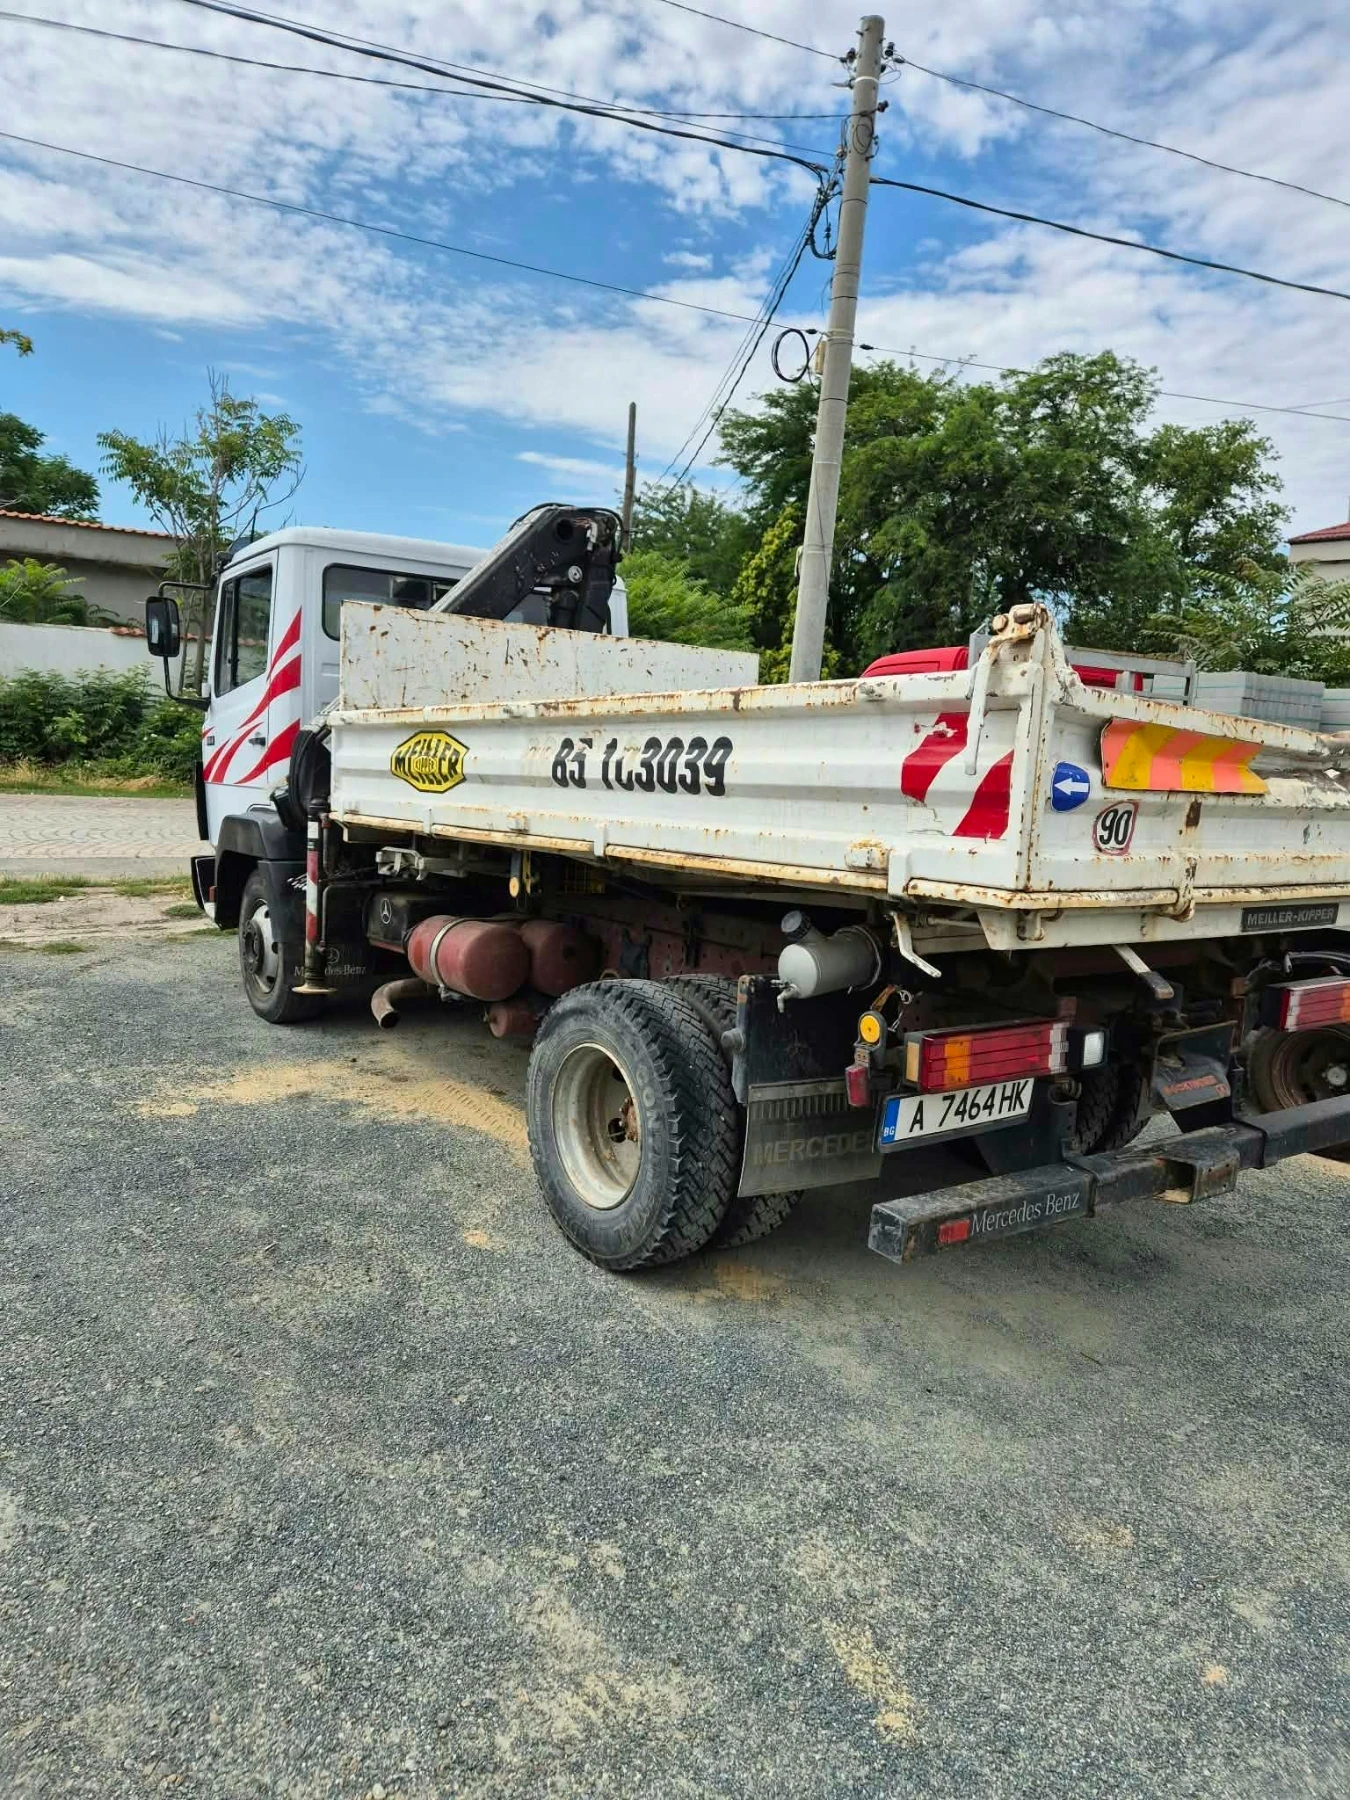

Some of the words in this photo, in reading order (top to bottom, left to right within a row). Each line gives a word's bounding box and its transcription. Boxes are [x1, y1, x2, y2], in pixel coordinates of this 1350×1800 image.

[395, 738, 461, 786] MEILLER
[1099, 808, 1133, 846] 90
[883, 1126, 895, 1137] BG
[909, 1099, 924, 1132] A
[970, 1200, 1041, 1236] Mercedes
[1045, 1192, 1080, 1216] Benz
